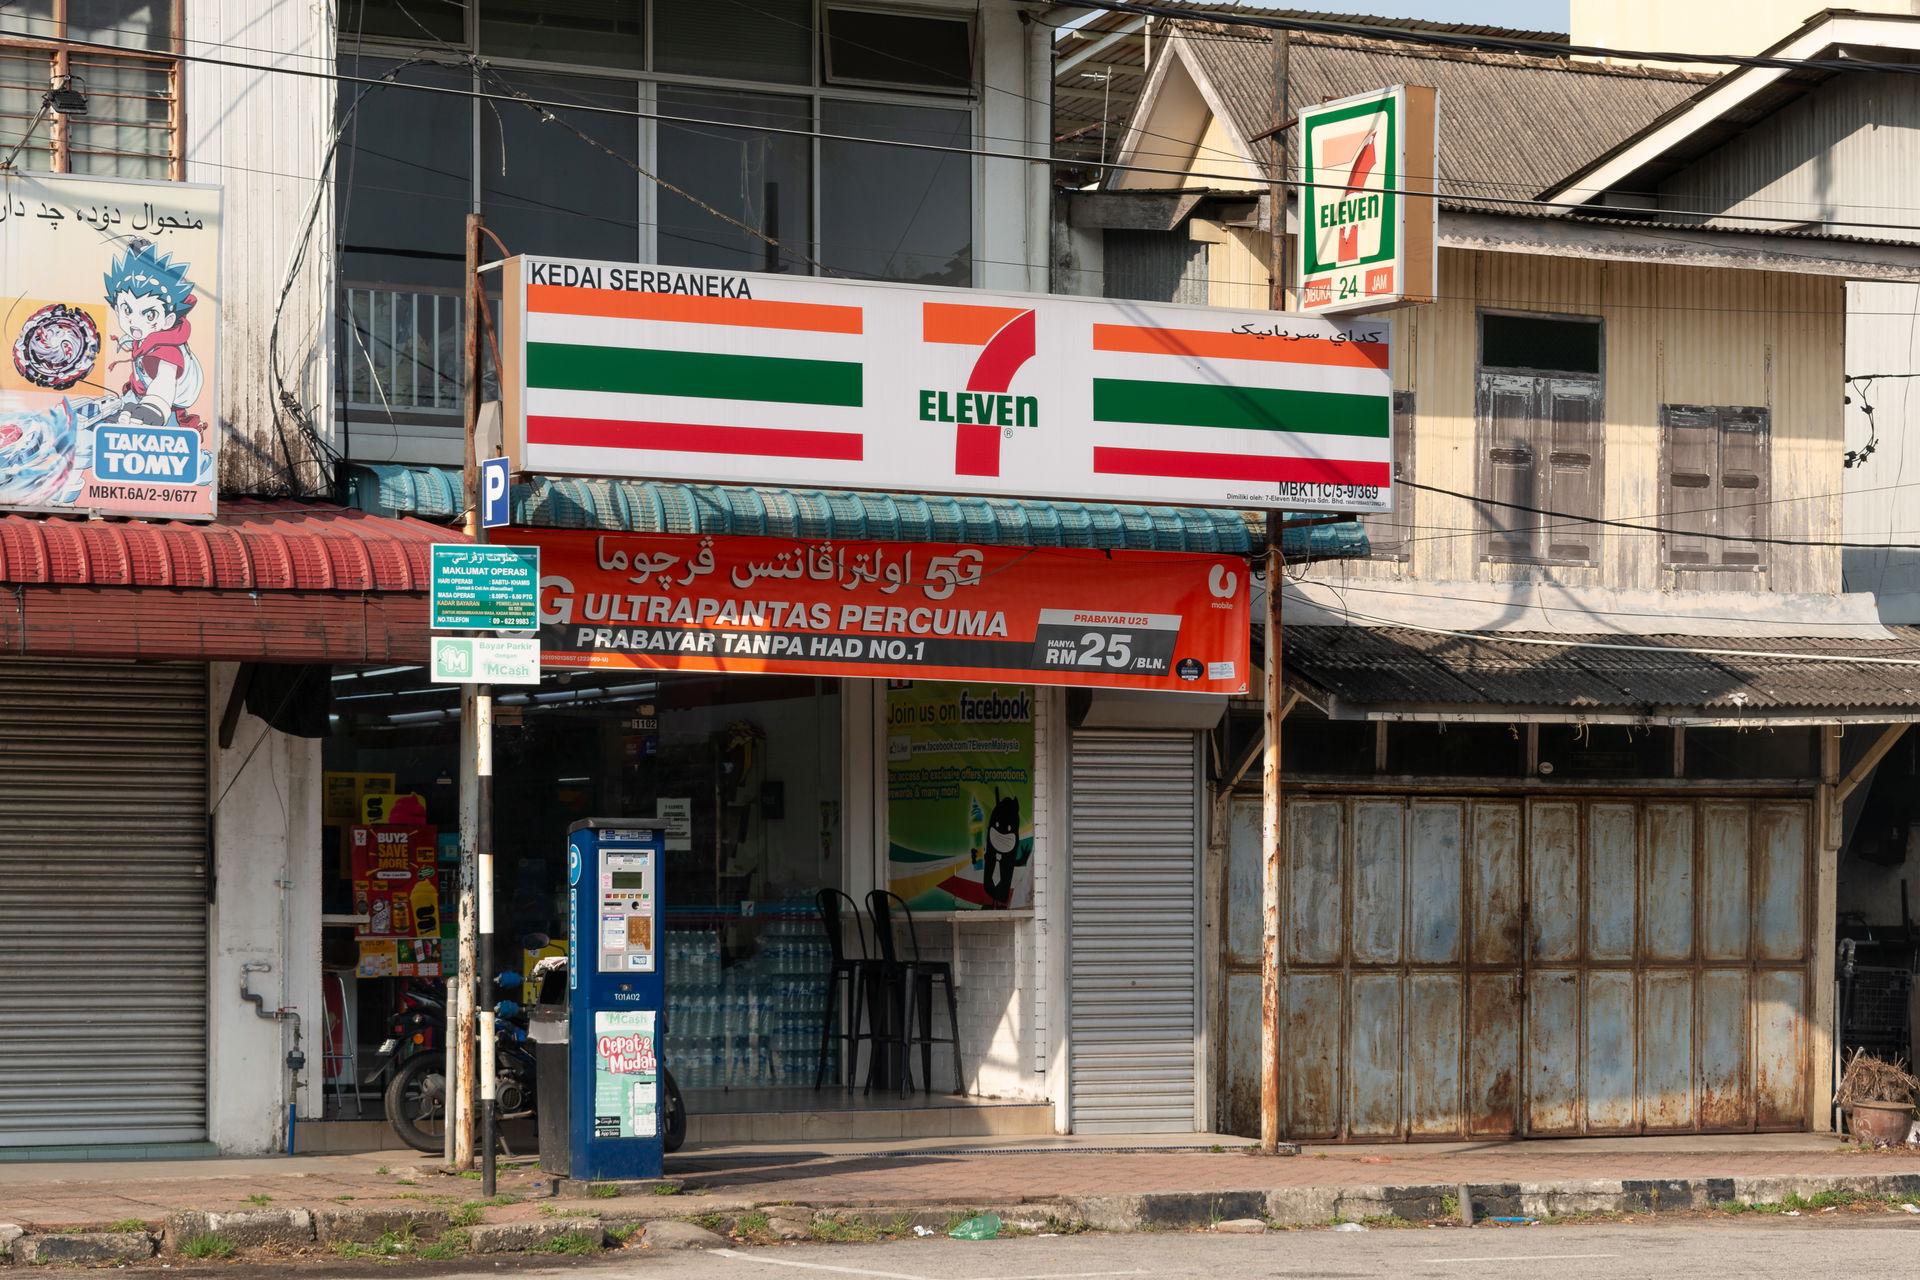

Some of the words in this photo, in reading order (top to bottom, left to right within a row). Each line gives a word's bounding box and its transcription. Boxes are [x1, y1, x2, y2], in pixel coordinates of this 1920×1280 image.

[531, 262, 602, 289] KEDAI
[609, 268, 752, 300] SERBANEKA
[1339, 275, 1358, 300] 24
[1371, 273, 1387, 291] JAM
[923, 302, 1036, 477] 7
[104, 432, 190, 454] TAKARA
[104, 452, 189, 476] TOMY
[89, 485, 198, 503] MBKT.6A/2-9/677
[486, 464, 505, 521] P
[1279, 481, 1379, 500] MBKT1C/5-9/369
[1291, 496, 1316, 504] Malaysia
[442, 567, 489, 576] MAKLUMAT
[490, 568, 528, 577] OPERASI
[923, 548, 984, 601] 5G
[583, 593, 831, 631] ULTRAPANTAS
[838, 603, 1008, 638] PERCUMA
[1211, 601, 1233, 610] mobile
[1074, 614, 1126, 625] PRABAYAR
[1127, 616, 1149, 626] U25
[479, 642, 505, 651] Bayar
[506, 642, 533, 651] Parkir
[576, 628, 716, 653] PRABAYAR
[721, 632, 804, 657] TANPA
[809, 636, 865, 660] HAD
[869, 639, 925, 662] NO.1
[1048, 639, 1076, 649] HANYA
[487, 663, 529, 677] MCash
[887, 702, 915, 724] Join
[919, 703, 935, 722] us
[939, 703, 956, 721] on
[959, 690, 1031, 720] facebook
[377, 843, 409, 858] SAVE
[377, 858, 410, 870] MORE
[608, 1013, 648, 1025] MCash
[599, 1033, 643, 1057] Cepat
[643, 1037, 651, 1050] &
[609, 1050, 657, 1074] Mudah
